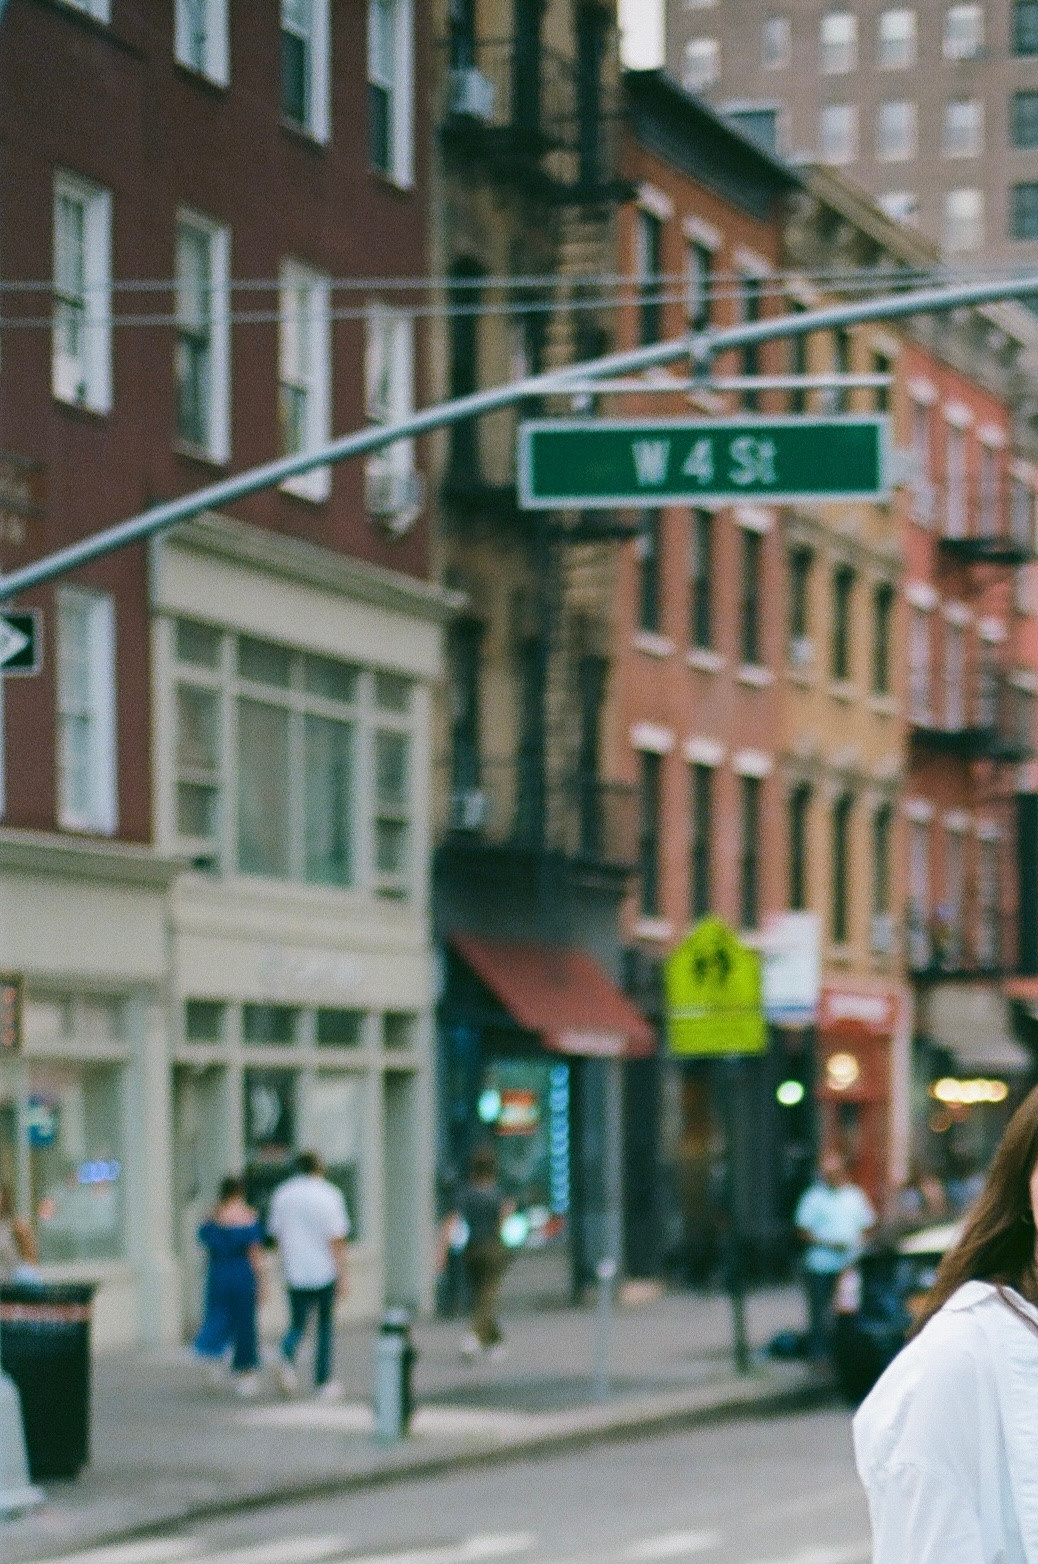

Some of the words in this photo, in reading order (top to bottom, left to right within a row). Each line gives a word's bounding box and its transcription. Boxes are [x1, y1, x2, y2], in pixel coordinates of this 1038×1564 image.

[632, 439, 671, 486] W
[681, 437, 714, 485] 4
[729, 436, 777, 485] St
